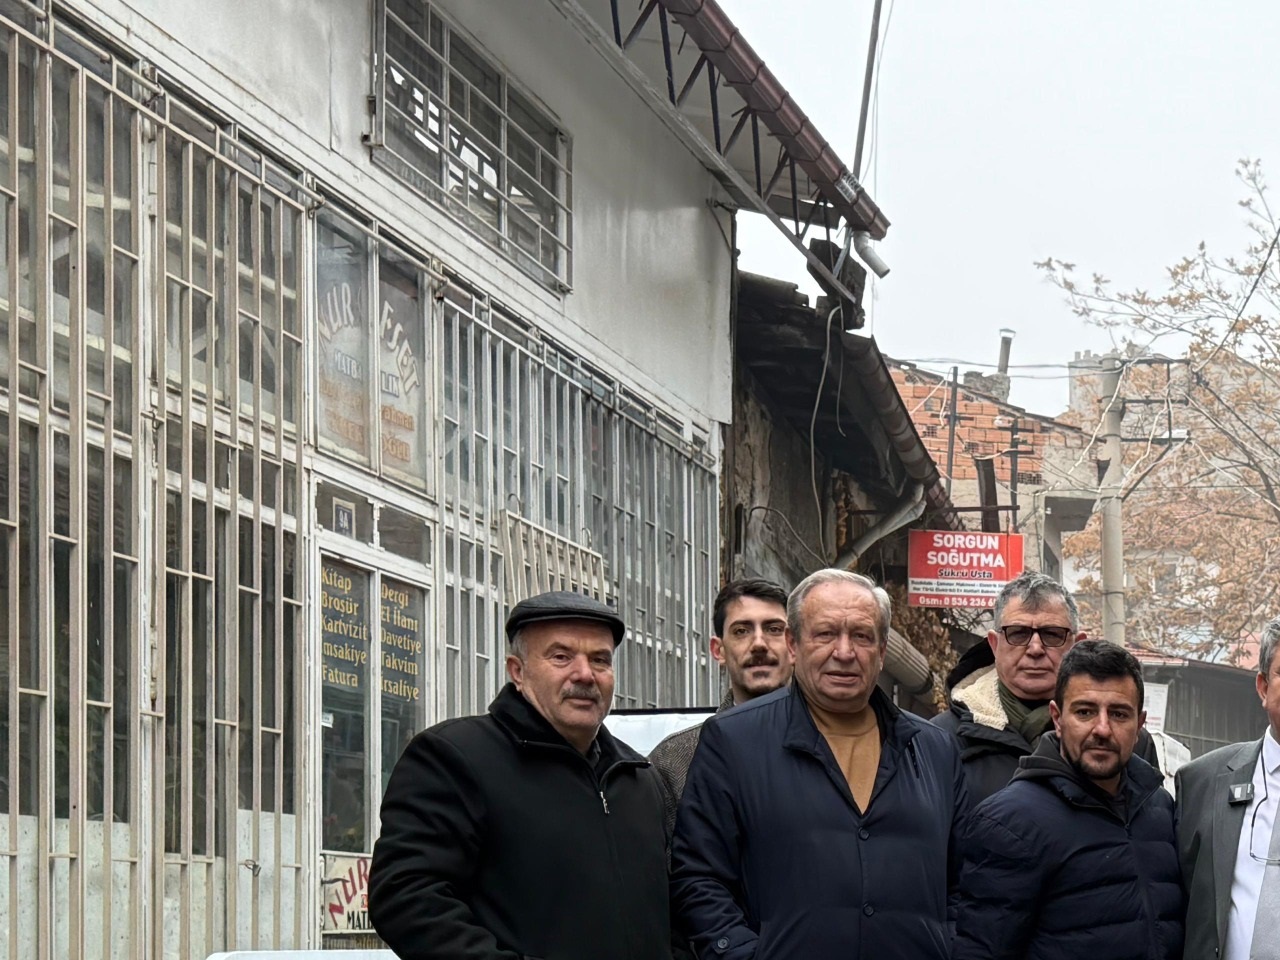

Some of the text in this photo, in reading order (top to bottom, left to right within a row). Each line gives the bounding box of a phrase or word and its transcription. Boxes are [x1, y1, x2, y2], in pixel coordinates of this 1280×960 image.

[933, 533, 999, 549] SORGUN
[927, 549, 1006, 568] SOĞUTMA
[321, 567, 352, 594] Kitap
[970, 570, 993, 579] Usta
[321, 591, 359, 618] Broşür
[381, 583, 409, 609] Dergi
[944, 597, 950, 605] 0
[952, 597, 968, 606] 536
[969, 597, 986, 607] 236
[321, 613, 368, 640] Kartvizit
[381, 604, 390, 623] El
[321, 641, 368, 667] msakiye
[381, 627, 422, 655] Davetiye
[321, 664, 358, 688] Fatura
[381, 650, 418, 676] Takvim
[328, 857, 371, 930] NUR
